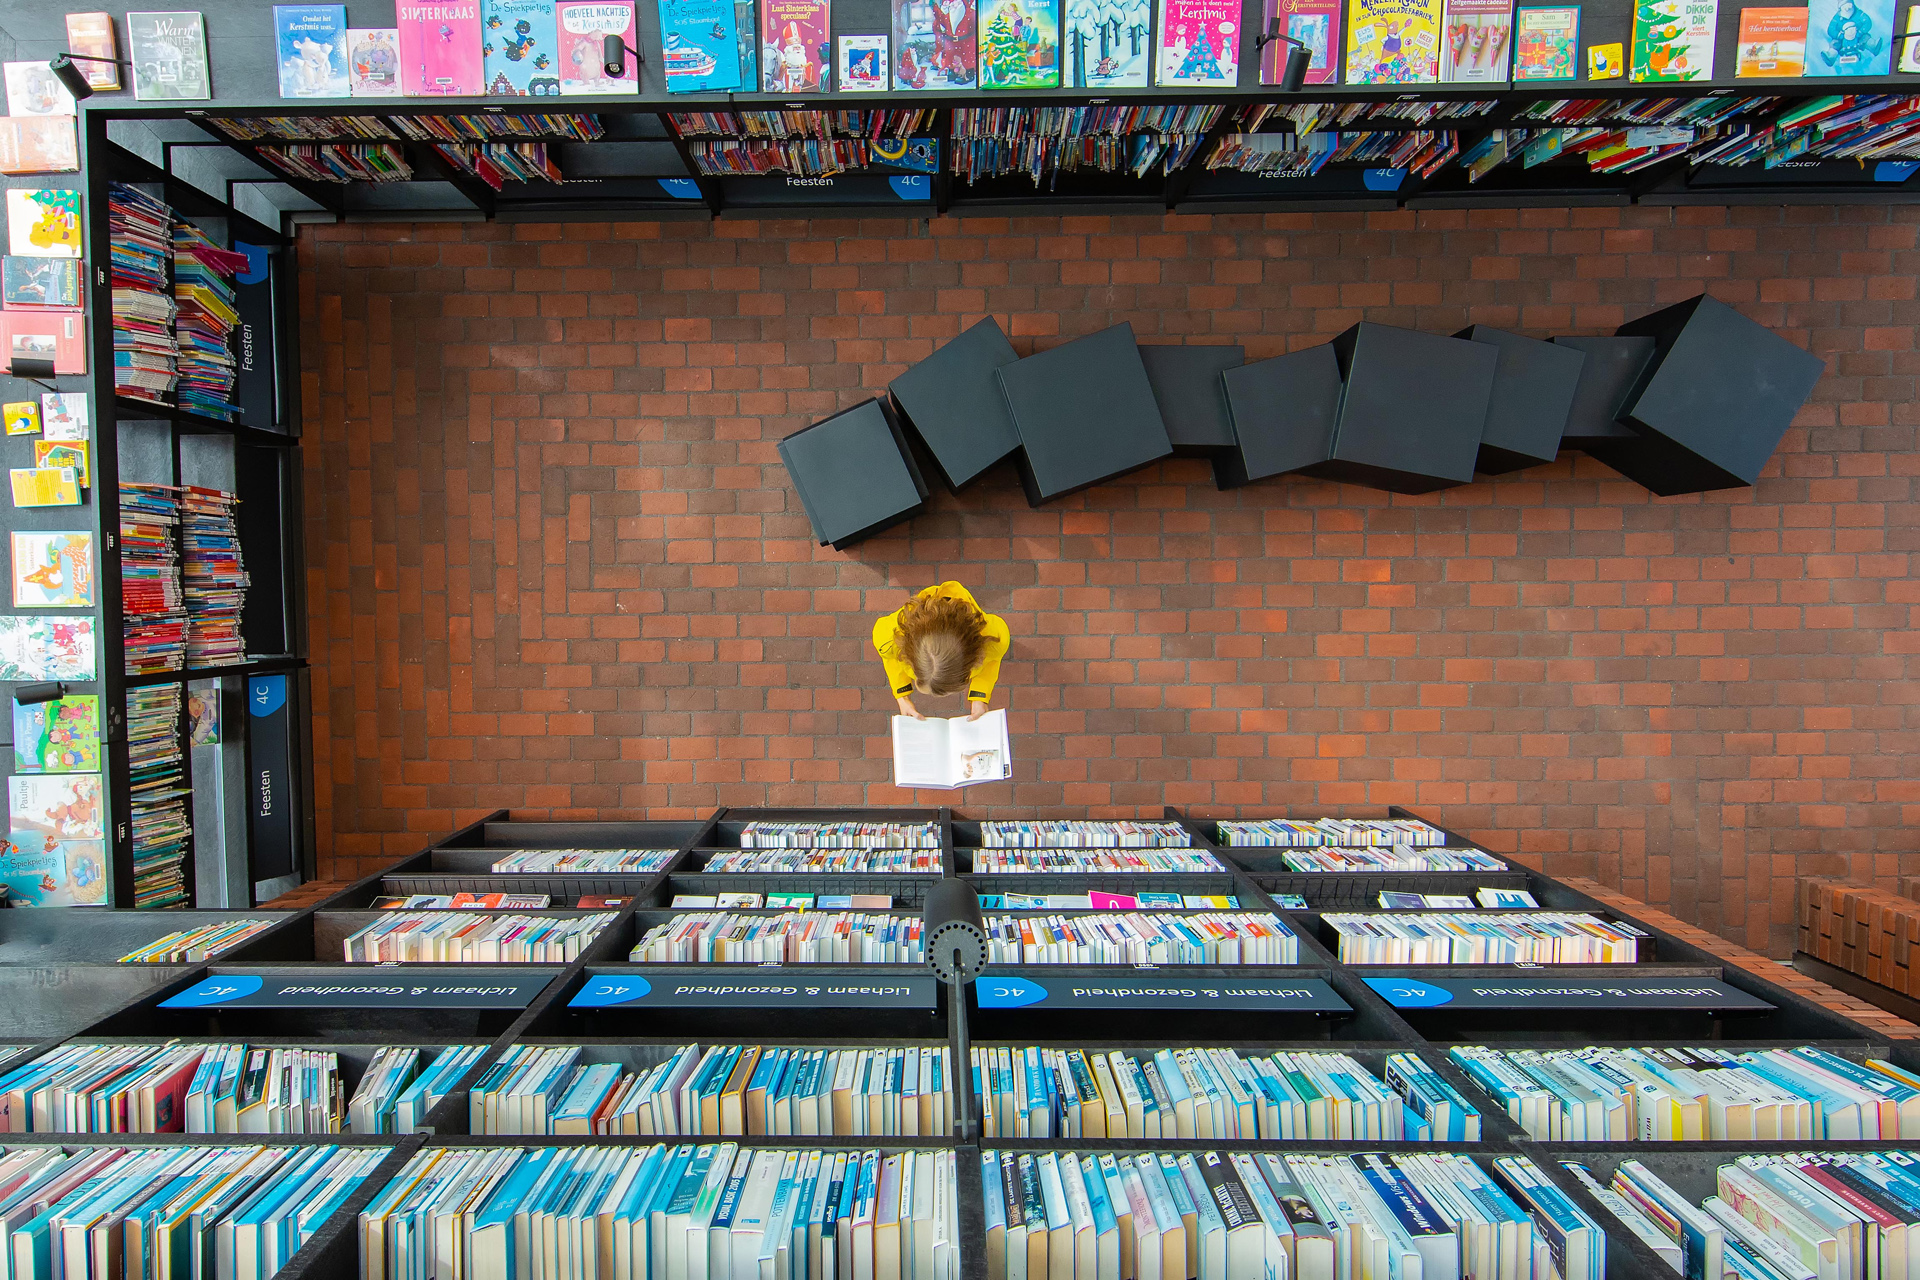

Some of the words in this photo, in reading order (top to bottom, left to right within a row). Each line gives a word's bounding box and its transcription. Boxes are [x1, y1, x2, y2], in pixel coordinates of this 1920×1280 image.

[491, 3, 502, 12] De
[772, 4, 785, 12] Lust
[786, 4, 819, 12] Sinterklaas
[1028, 0, 1050, 8] Kerst
[401, 6, 475, 20] SINTERKLAAS
[564, 8, 595, 18] HOEVEEL
[596, 7, 630, 17] NACHTJES
[668, 7, 681, 17] De
[780, 12, 811, 20] speculaas?
[1180, 6, 1226, 20] Kerstmis
[1371, 7, 1436, 25] CHOCOLADEFABRIEK
[155, 18, 195, 36] Warm
[290, 23, 319, 31] Kerstmis
[158, 37, 196, 46] WINTER
[786, 177, 834, 187] Feesten
[902, 176, 921, 187] 4C
[242, 324, 253, 371] Feesten
[256, 685, 269, 705] 4C
[20, 780, 29, 810] Paultje
[261, 770, 271, 817] Feesten
[199, 986, 238, 996] 4C
[278, 985, 405, 996] Gezondheid
[411, 985, 429, 996] &
[432, 985, 516, 996] Lichaam
[595, 986, 630, 995] 4C
[675, 986, 797, 996] Gezondheid
[804, 986, 821, 996] &
[827, 986, 910, 996] Lichaam
[994, 987, 1025, 997] 4C
[1073, 988, 1196, 998] Gezondheid
[1201, 988, 1218, 997] &
[1224, 988, 1313, 998] Lichaam
[1393, 988, 1426, 997] 4C
[1473, 988, 1602, 997] Gezondheid
[1603, 988, 1626, 997] &
[1627, 987, 1723, 997] Lichaam
[717, 1204, 728, 1220] VISUAL
[723, 1191, 733, 1204] BASIC
[729, 1177, 740, 1191] 2005
[1778, 1189, 1805, 1209] love
[1399, 1196, 1431, 1228] Windows
[1872, 1210, 1888, 1221] LUCY
